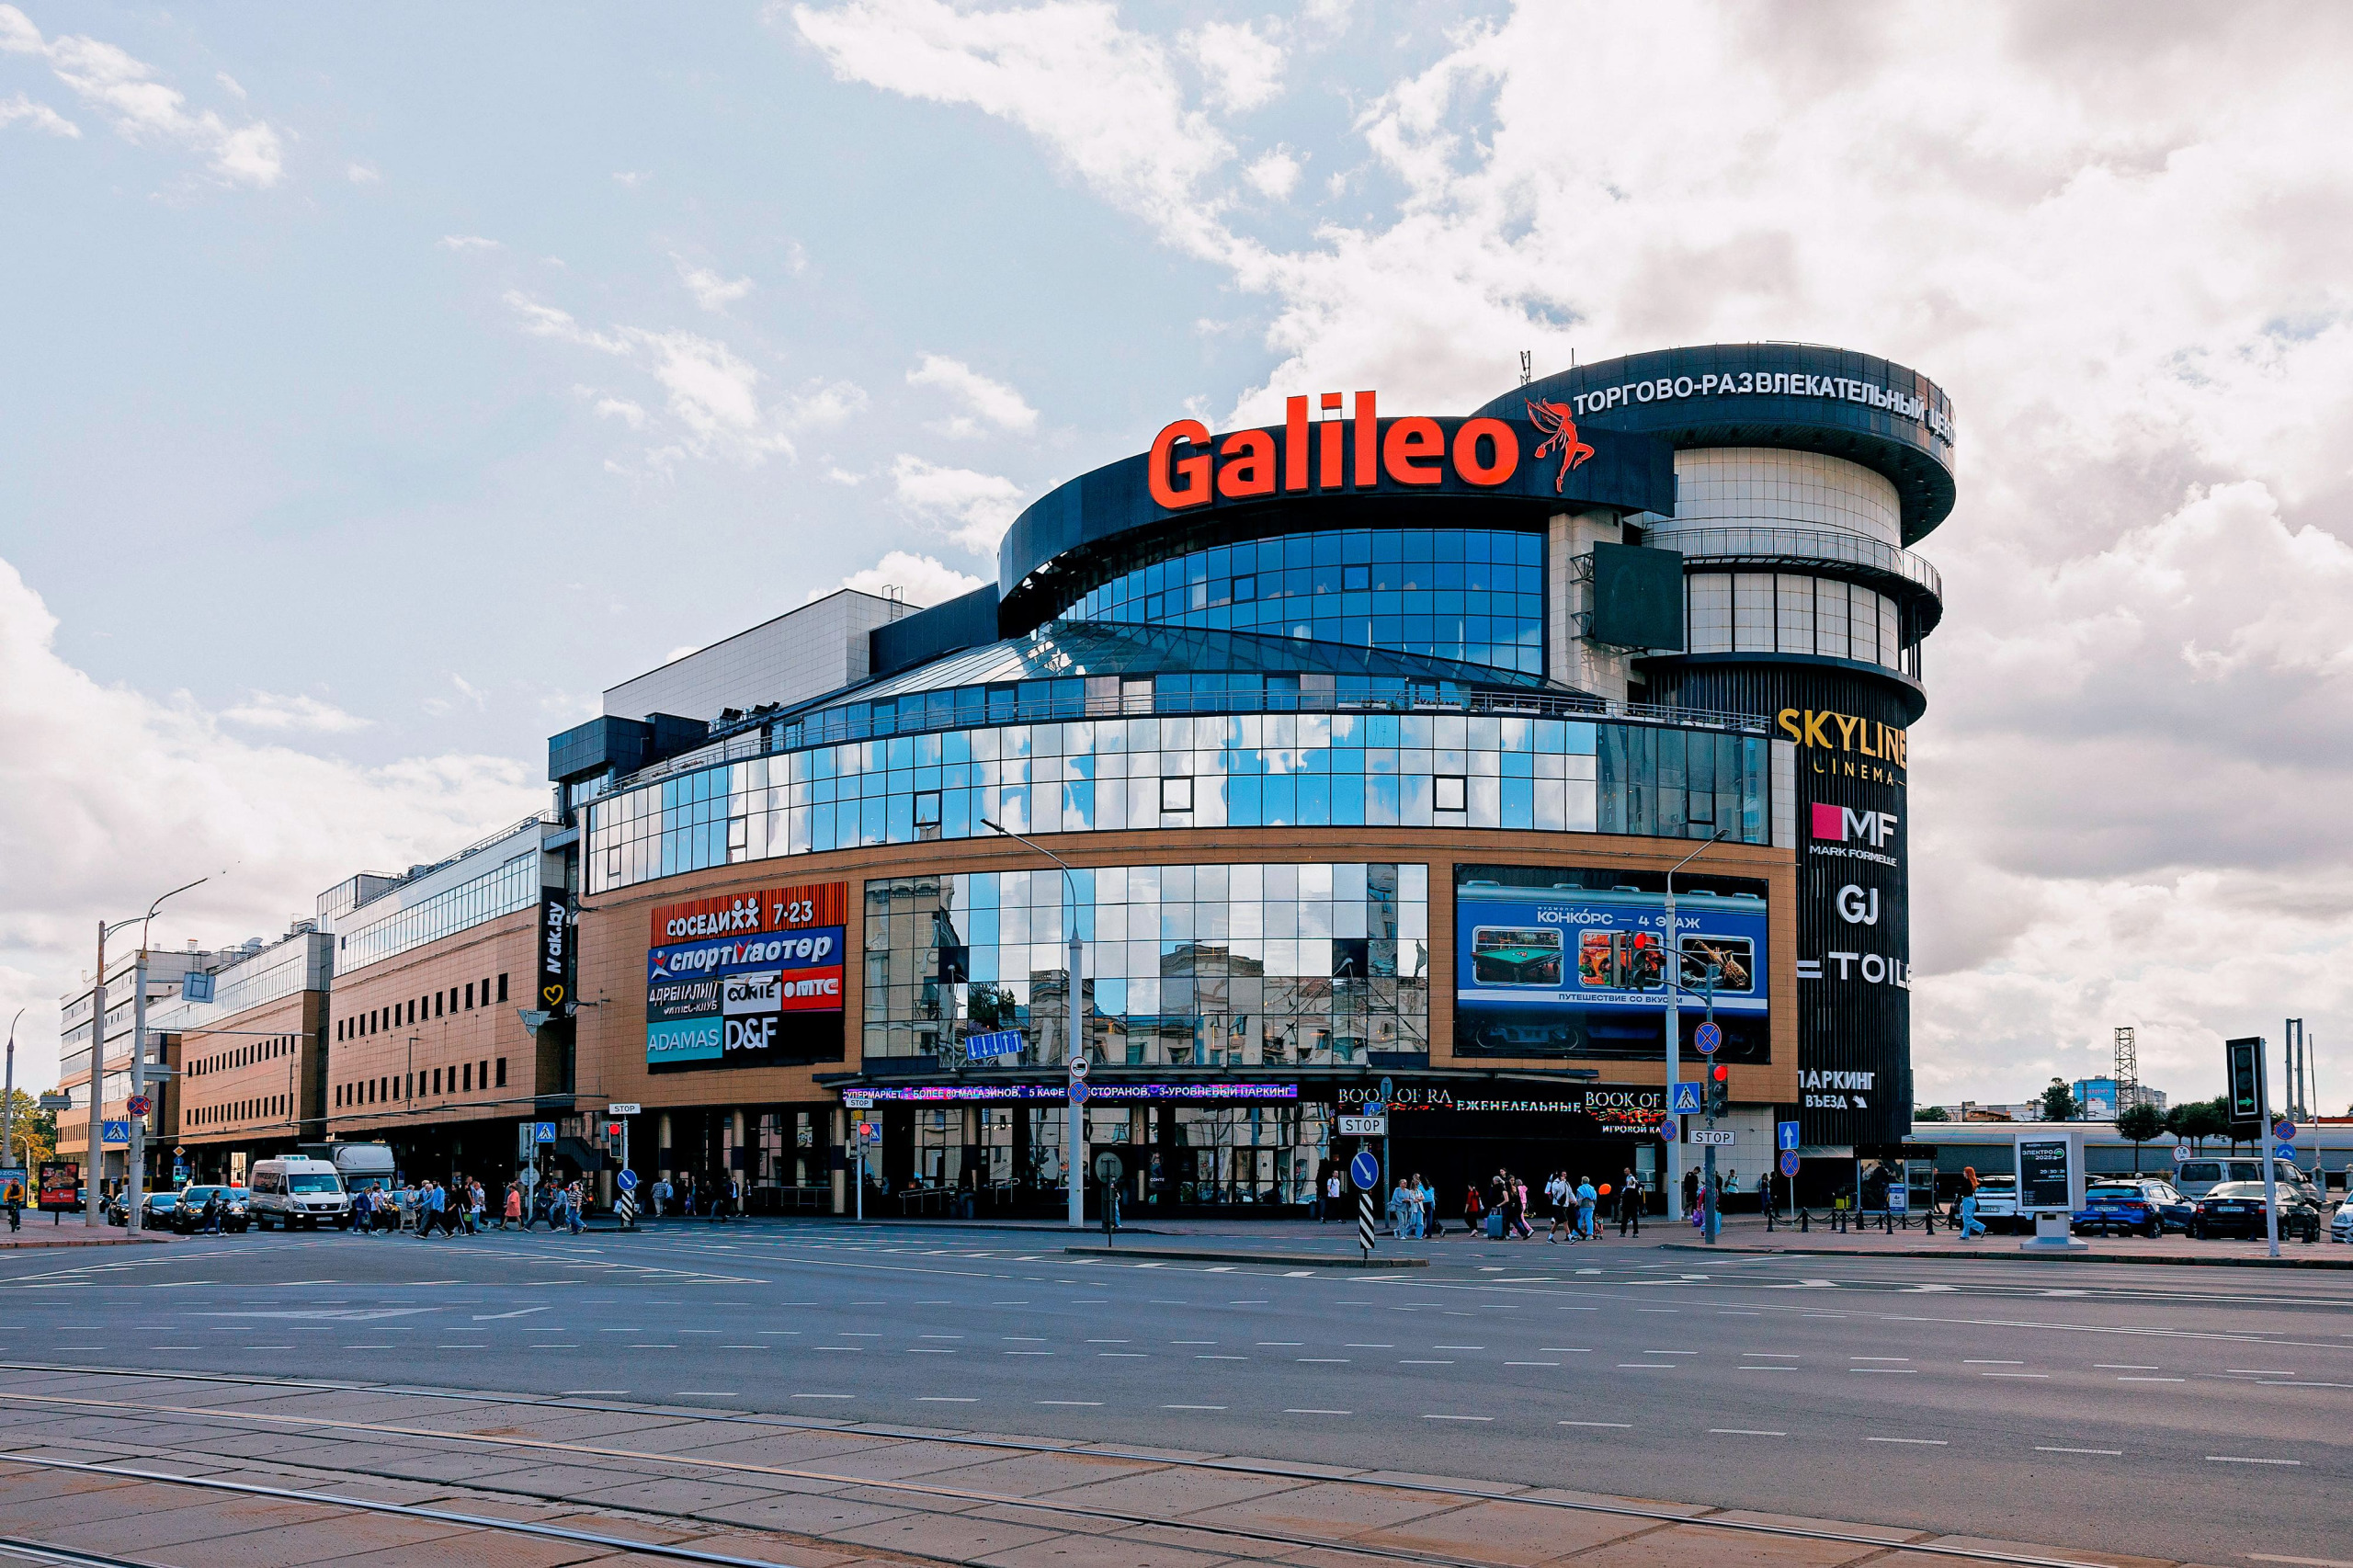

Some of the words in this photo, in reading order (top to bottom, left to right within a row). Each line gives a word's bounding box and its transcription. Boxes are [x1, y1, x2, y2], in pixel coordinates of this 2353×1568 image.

[1573, 371, 1925, 422] ТОРГОВО-РАЗВЛЕКАТЕЛЬНЫЙ
[1148, 390, 1519, 511] Galileo
[1778, 708, 1906, 770] SKYLINE
[1842, 806, 1897, 848] MF
[1809, 845, 1847, 858] MARK
[1848, 848, 1897, 867] FORMELLE
[1836, 884, 1878, 926] GJ
[667, 911, 730, 937] СОСЕДИ
[1638, 915, 1649, 926] 4
[1655, 916, 1700, 928] ЭАЖ
[1559, 994, 1626, 1002] ПУТЕШЕСТВИЕ
[647, 1028, 720, 1051] ADAMAS
[725, 1017, 778, 1051] D&F
[913, 1089, 944, 1097] БОЛЕЕ
[1029, 1088, 1035, 1097] 5
[1037, 1088, 1064, 1096] КАФЕ
[1158, 1085, 1238, 1096] 3-УРОВНЕВЫЙ
[1241, 1086, 1291, 1096] ПАРКИНГ
[1338, 1088, 1392, 1103] BOO
[1397, 1088, 1421, 1103] OF
[1427, 1088, 1452, 1103] RA
[1586, 1091, 1635, 1107] BOOK
[1639, 1093, 1660, 1107] OF
[1805, 1095, 1847, 1109] ВЪЕЗД
[1346, 1119, 1380, 1131] STOP
[1696, 1132, 1730, 1143] STOP
